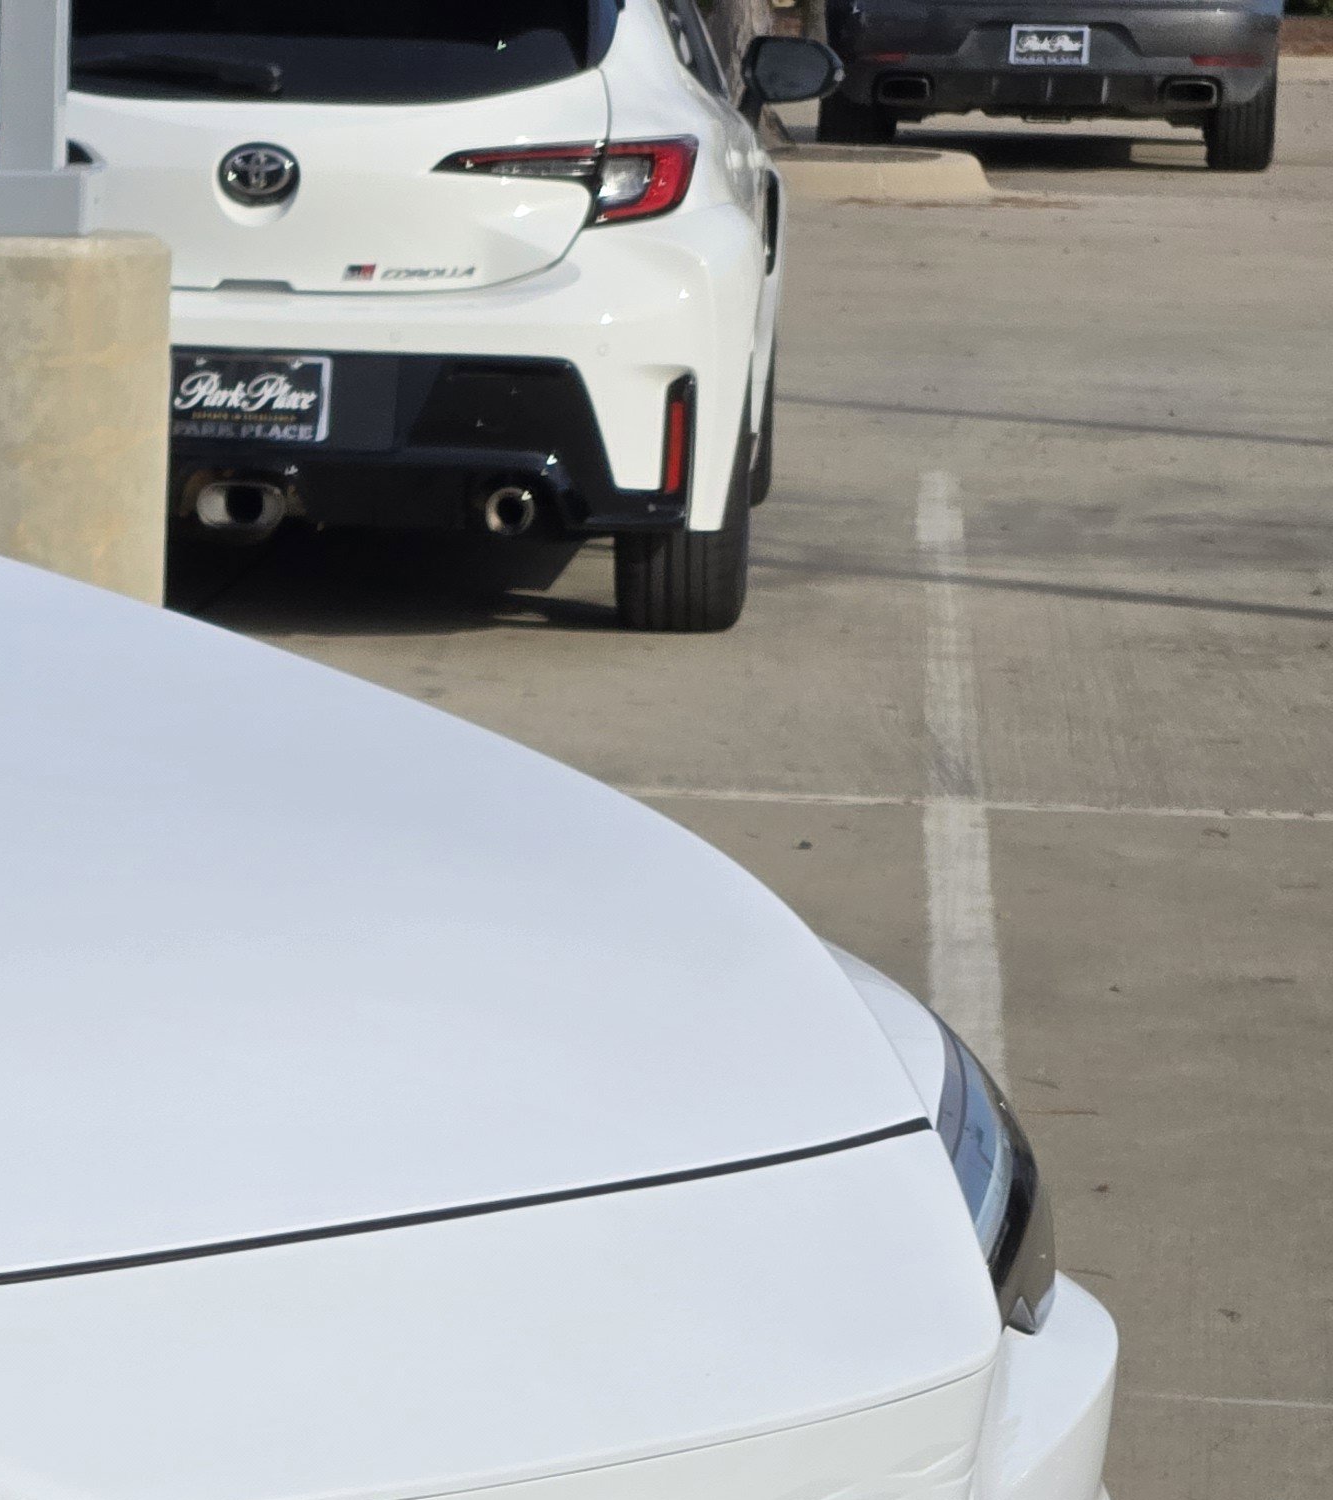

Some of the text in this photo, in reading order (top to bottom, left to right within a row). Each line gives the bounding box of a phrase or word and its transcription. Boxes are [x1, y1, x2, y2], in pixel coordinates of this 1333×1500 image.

[174, 371, 318, 411] Park Place
[241, 424, 313, 440] PLACE
